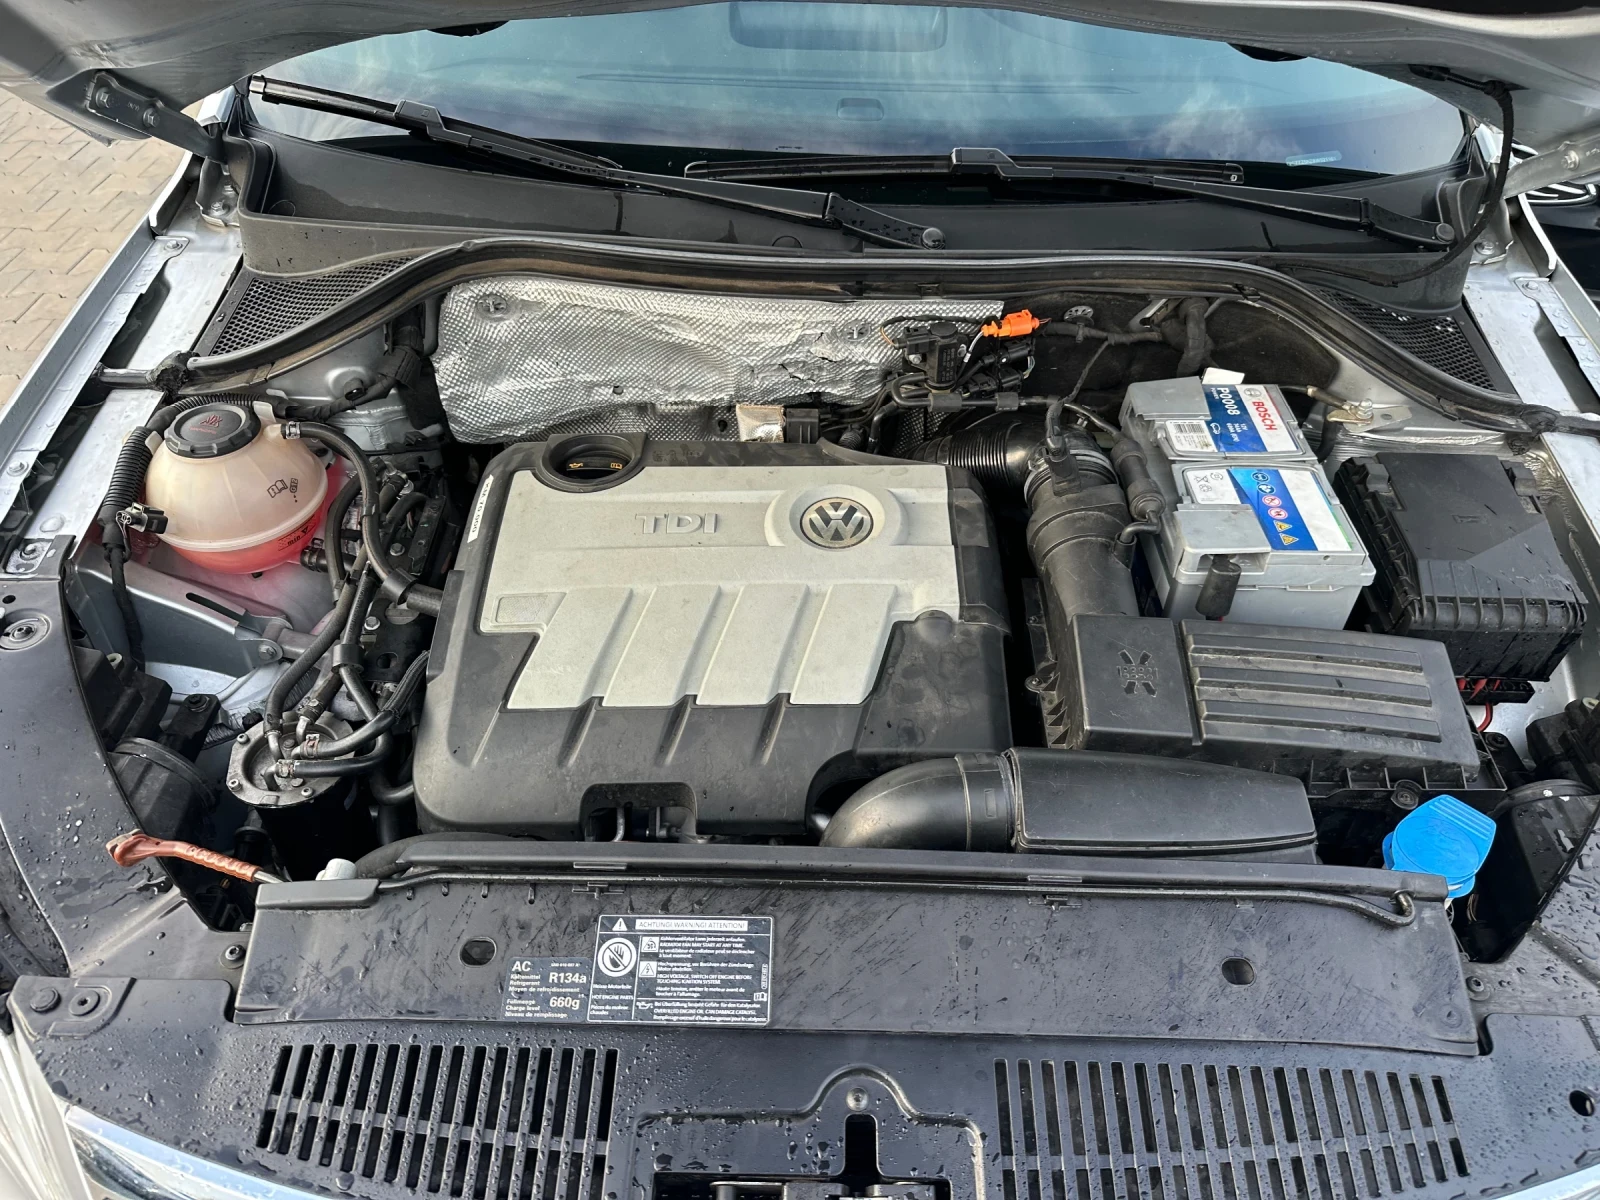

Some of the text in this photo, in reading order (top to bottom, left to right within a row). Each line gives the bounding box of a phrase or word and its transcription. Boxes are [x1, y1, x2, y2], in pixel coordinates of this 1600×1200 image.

[1217, 387, 1240, 416] P0008
[1252, 401, 1278, 431] BOSCH
[635, 513, 718, 535] TDI
[288, 535, 300, 546] min
[512, 960, 532, 972] AC
[548, 972, 587, 984] R134a
[550, 996, 580, 1010] 660g
